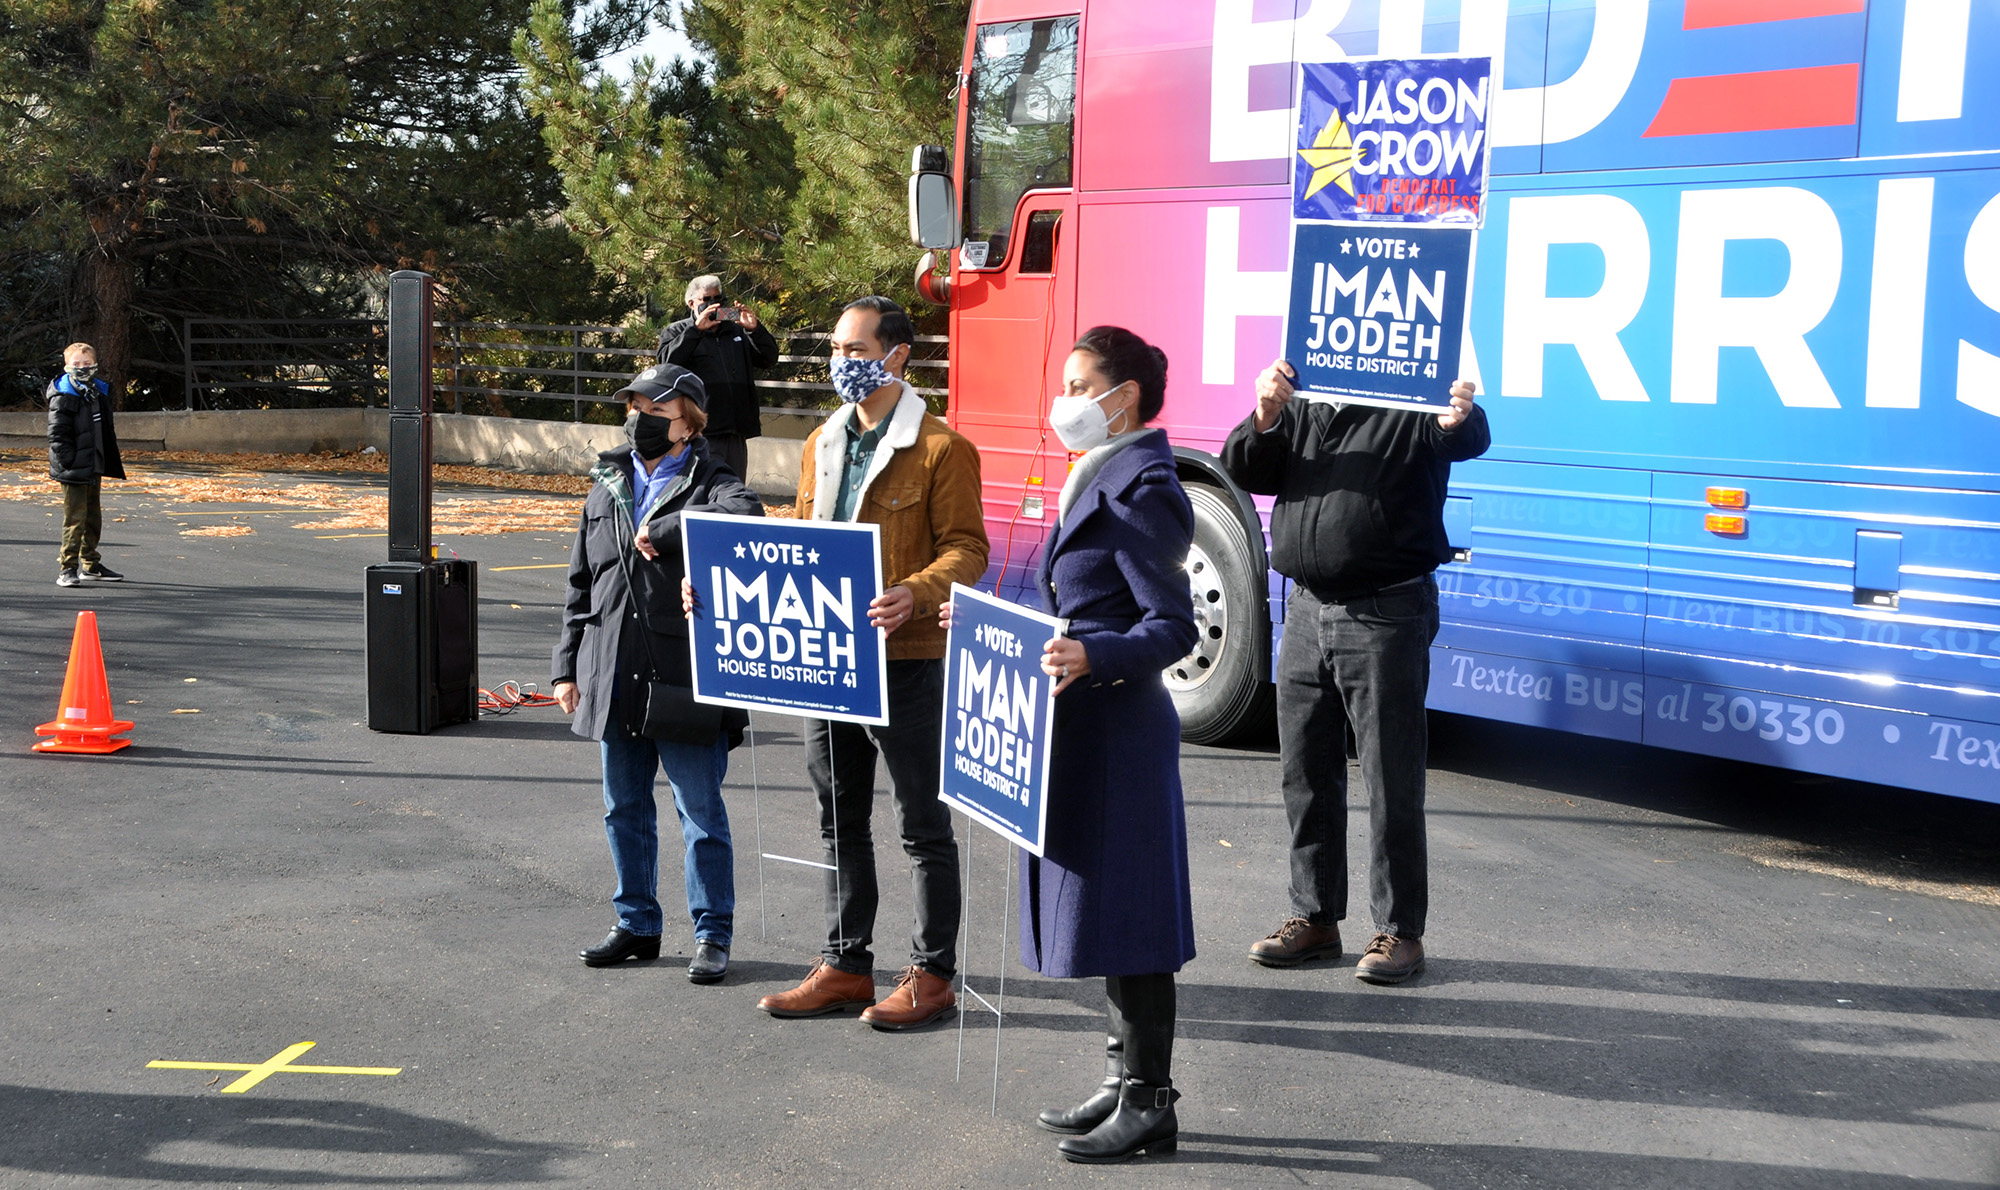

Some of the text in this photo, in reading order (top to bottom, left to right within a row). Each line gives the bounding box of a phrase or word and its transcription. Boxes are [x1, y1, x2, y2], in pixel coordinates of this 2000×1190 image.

[1210, 0, 1971, 163] BDE
[1346, 77, 1488, 125] JASON
[1351, 130, 1485, 176] CROW
[1356, 193, 1480, 215] FOR CONGRESS
[1381, 178, 1457, 195] DEMOCRAT
[1356, 237, 1406, 260] VOTE
[1202, 176, 2000, 418] HRRI
[1310, 262, 1447, 324] IMAN
[1306, 315, 1441, 361] JODEH
[1306, 352, 1438, 379] HOUSE DISTRICT 41
[749, 541, 805, 565] VOTE
[711, 565, 854, 632] IMAN
[1470, 576, 1593, 617] 30330
[715, 619, 856, 670] JODEH
[984, 623, 1015, 658] VOTE
[1659, 594, 1741, 632] Text
[1751, 604, 1847, 644] BUS
[1860, 619, 1900, 650] to
[718, 658, 857, 688] HOUSE DISTRICT 41
[957, 648, 1037, 741] IMAN
[1451, 654, 1845, 746] Textea BUS al 30330
[955, 710, 1033, 786] JODEH
[955, 753, 1030, 808] HOUSE DISTRICT 41
